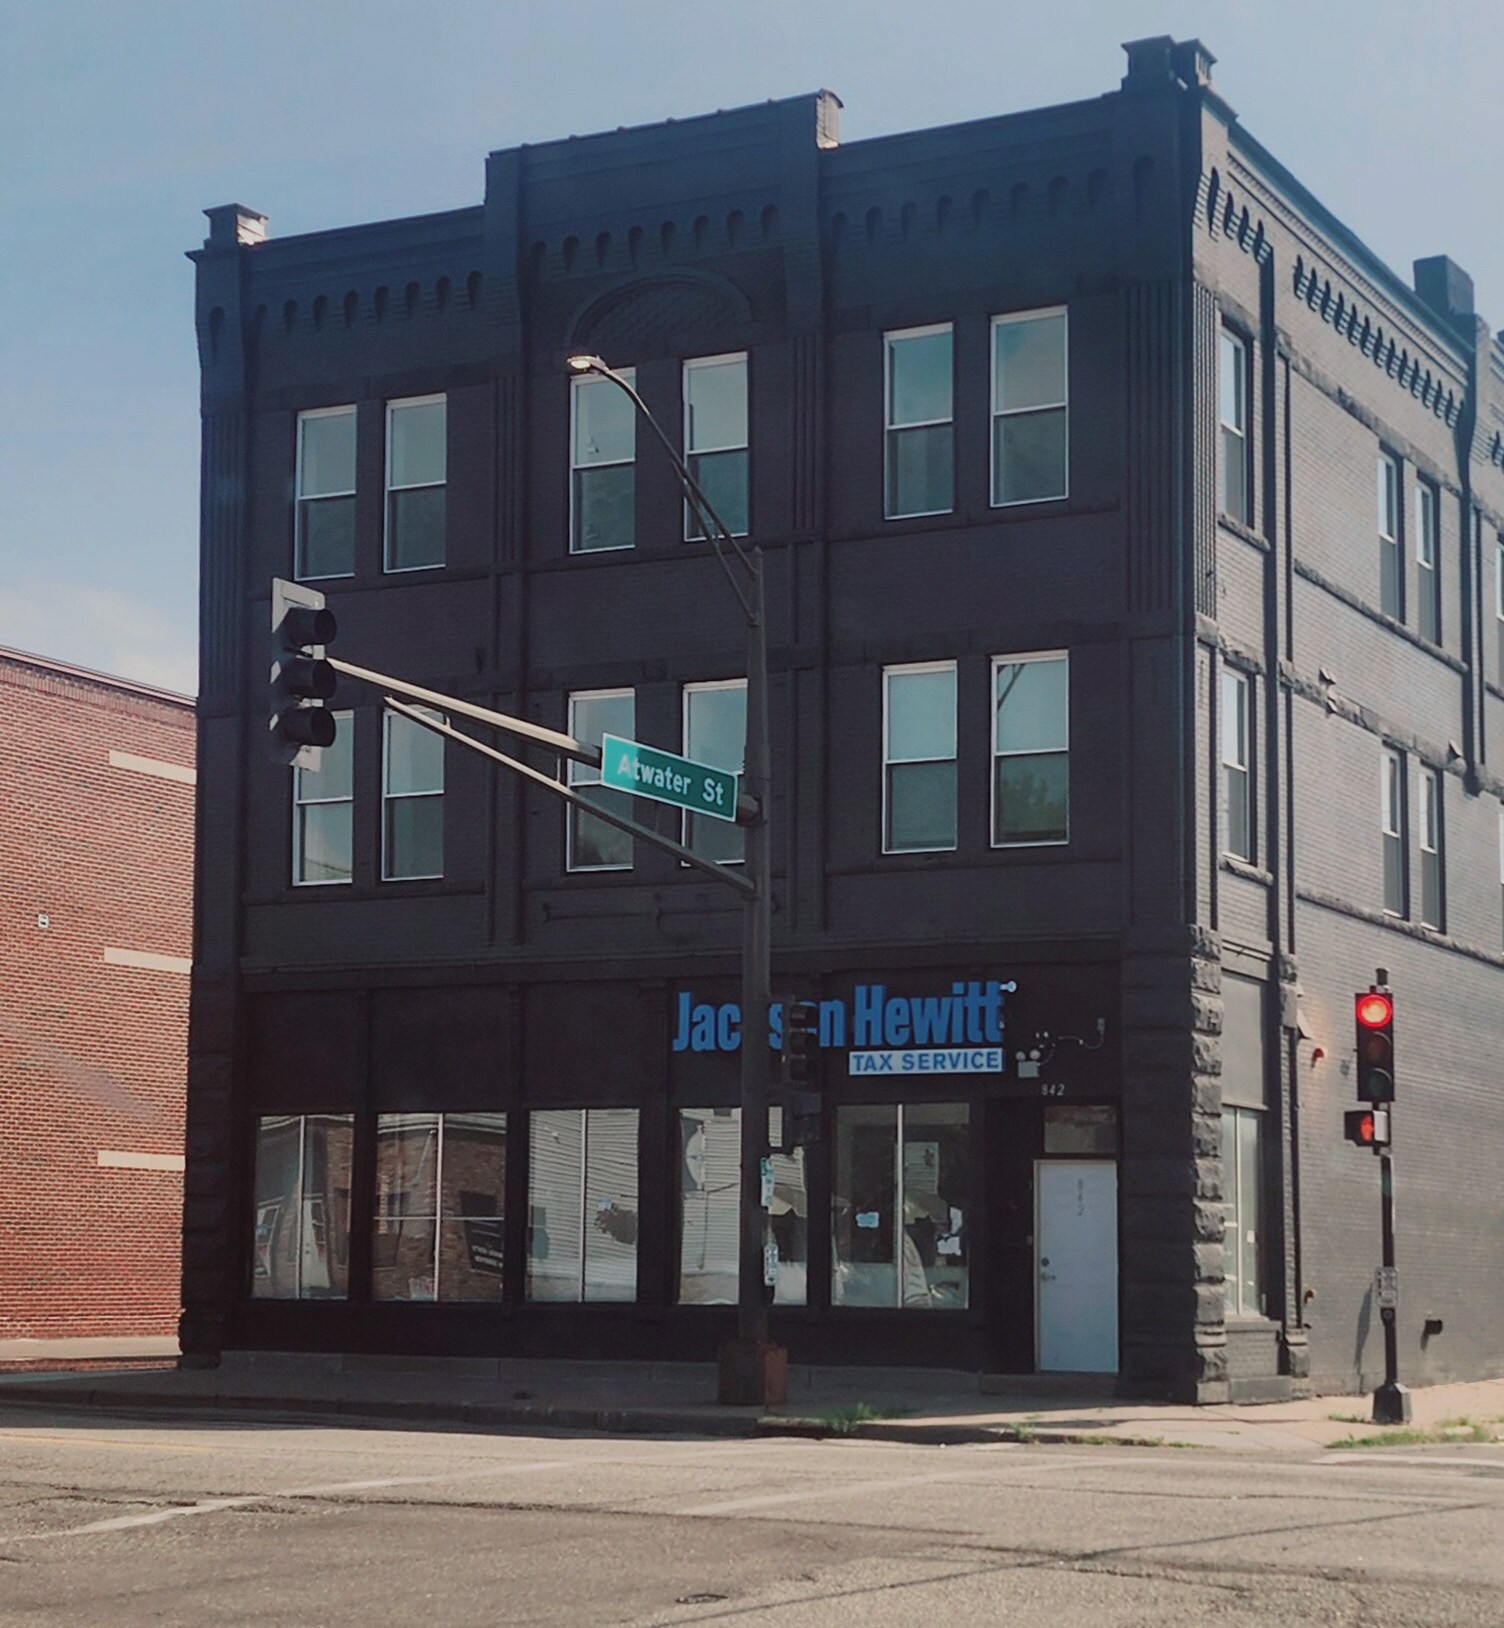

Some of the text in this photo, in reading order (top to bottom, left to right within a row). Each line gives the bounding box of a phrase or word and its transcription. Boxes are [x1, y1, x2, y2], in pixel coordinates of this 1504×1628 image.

[617, 753, 724, 806] Atwater St
[672, 979, 1004, 1052] Jacsn Hewitt
[853, 1051, 999, 1072] TAX SERVICE
